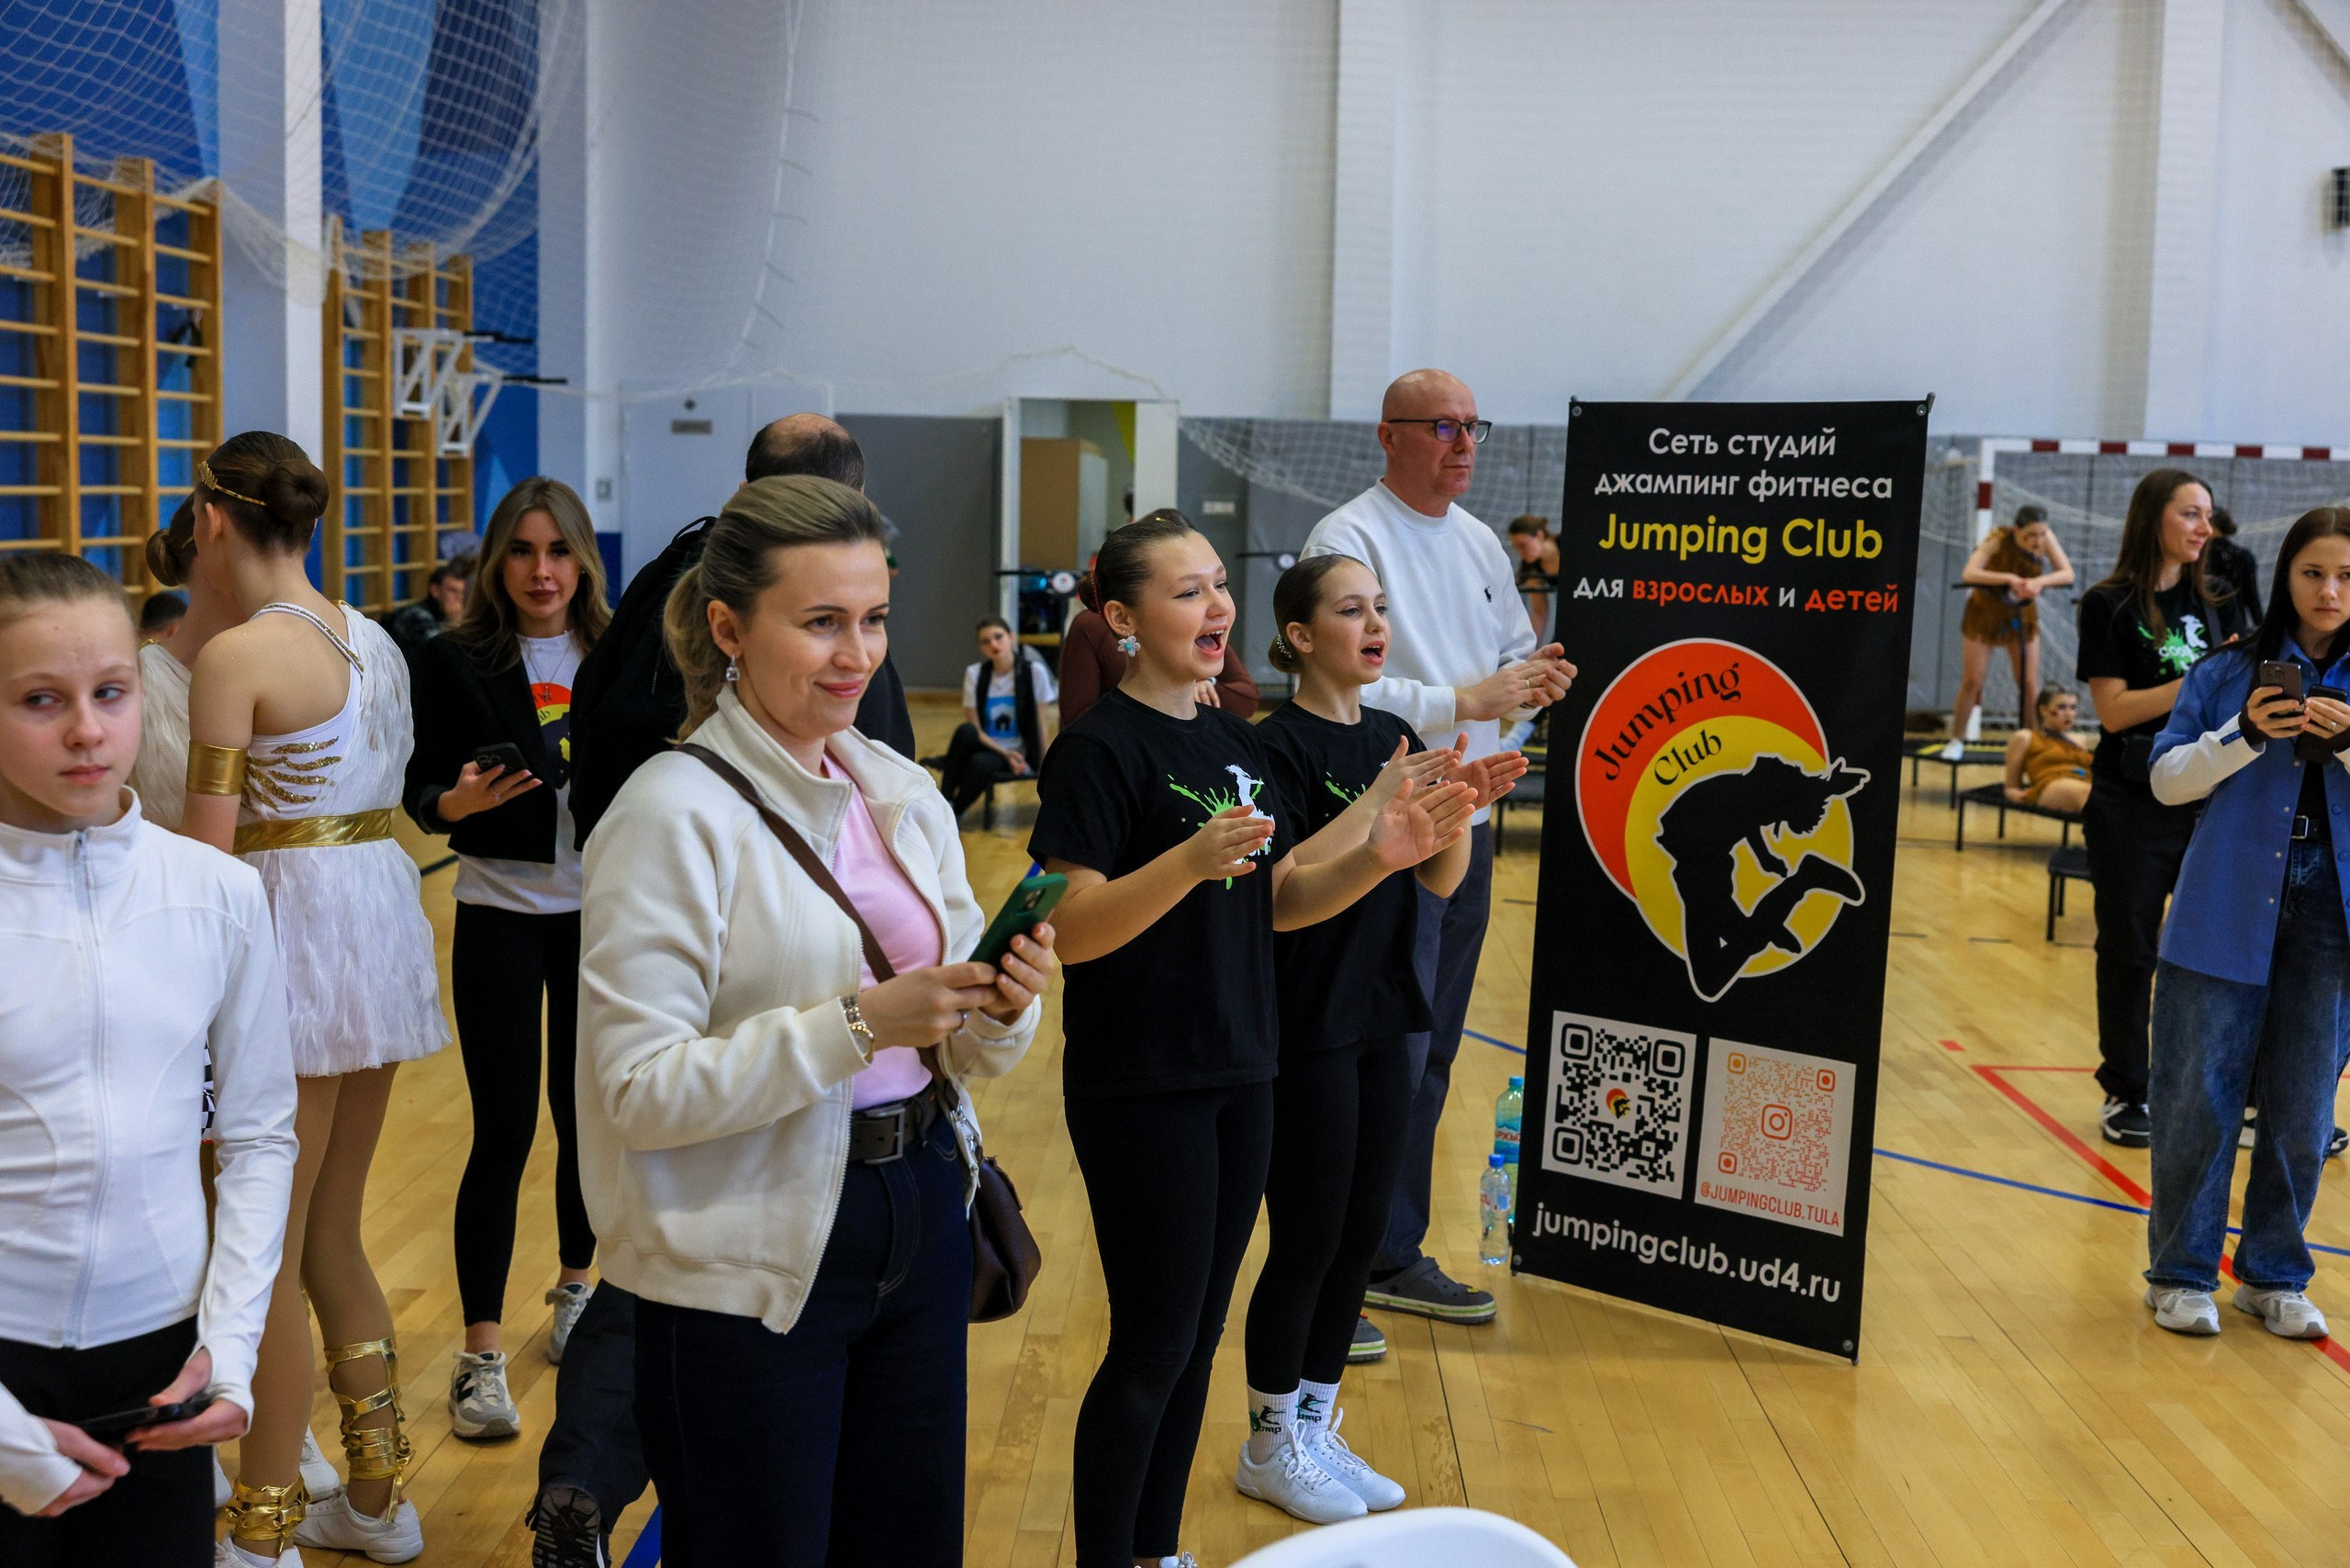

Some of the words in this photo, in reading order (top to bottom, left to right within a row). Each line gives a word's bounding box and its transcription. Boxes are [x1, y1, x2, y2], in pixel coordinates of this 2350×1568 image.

[1649, 427, 1718, 455] Сеть
[1728, 427, 1836, 462] студий
[1594, 473, 1740, 497] джампинг
[1748, 469, 1893, 503] фитнеса
[1598, 513, 1768, 565] Jumping
[1782, 518, 1883, 559] Club
[1572, 577, 1624, 599] для
[1632, 579, 1769, 607] взрослых
[1778, 587, 1796, 608] и
[1804, 583, 1898, 613] детей
[1594, 662, 1741, 780] Jumping
[1654, 729, 1722, 786] Club
[1700, 1181, 1840, 1227] @JUMPINGCLUB.TULA
[1532, 1202, 1841, 1303] jumpingclub.ud4.ru
